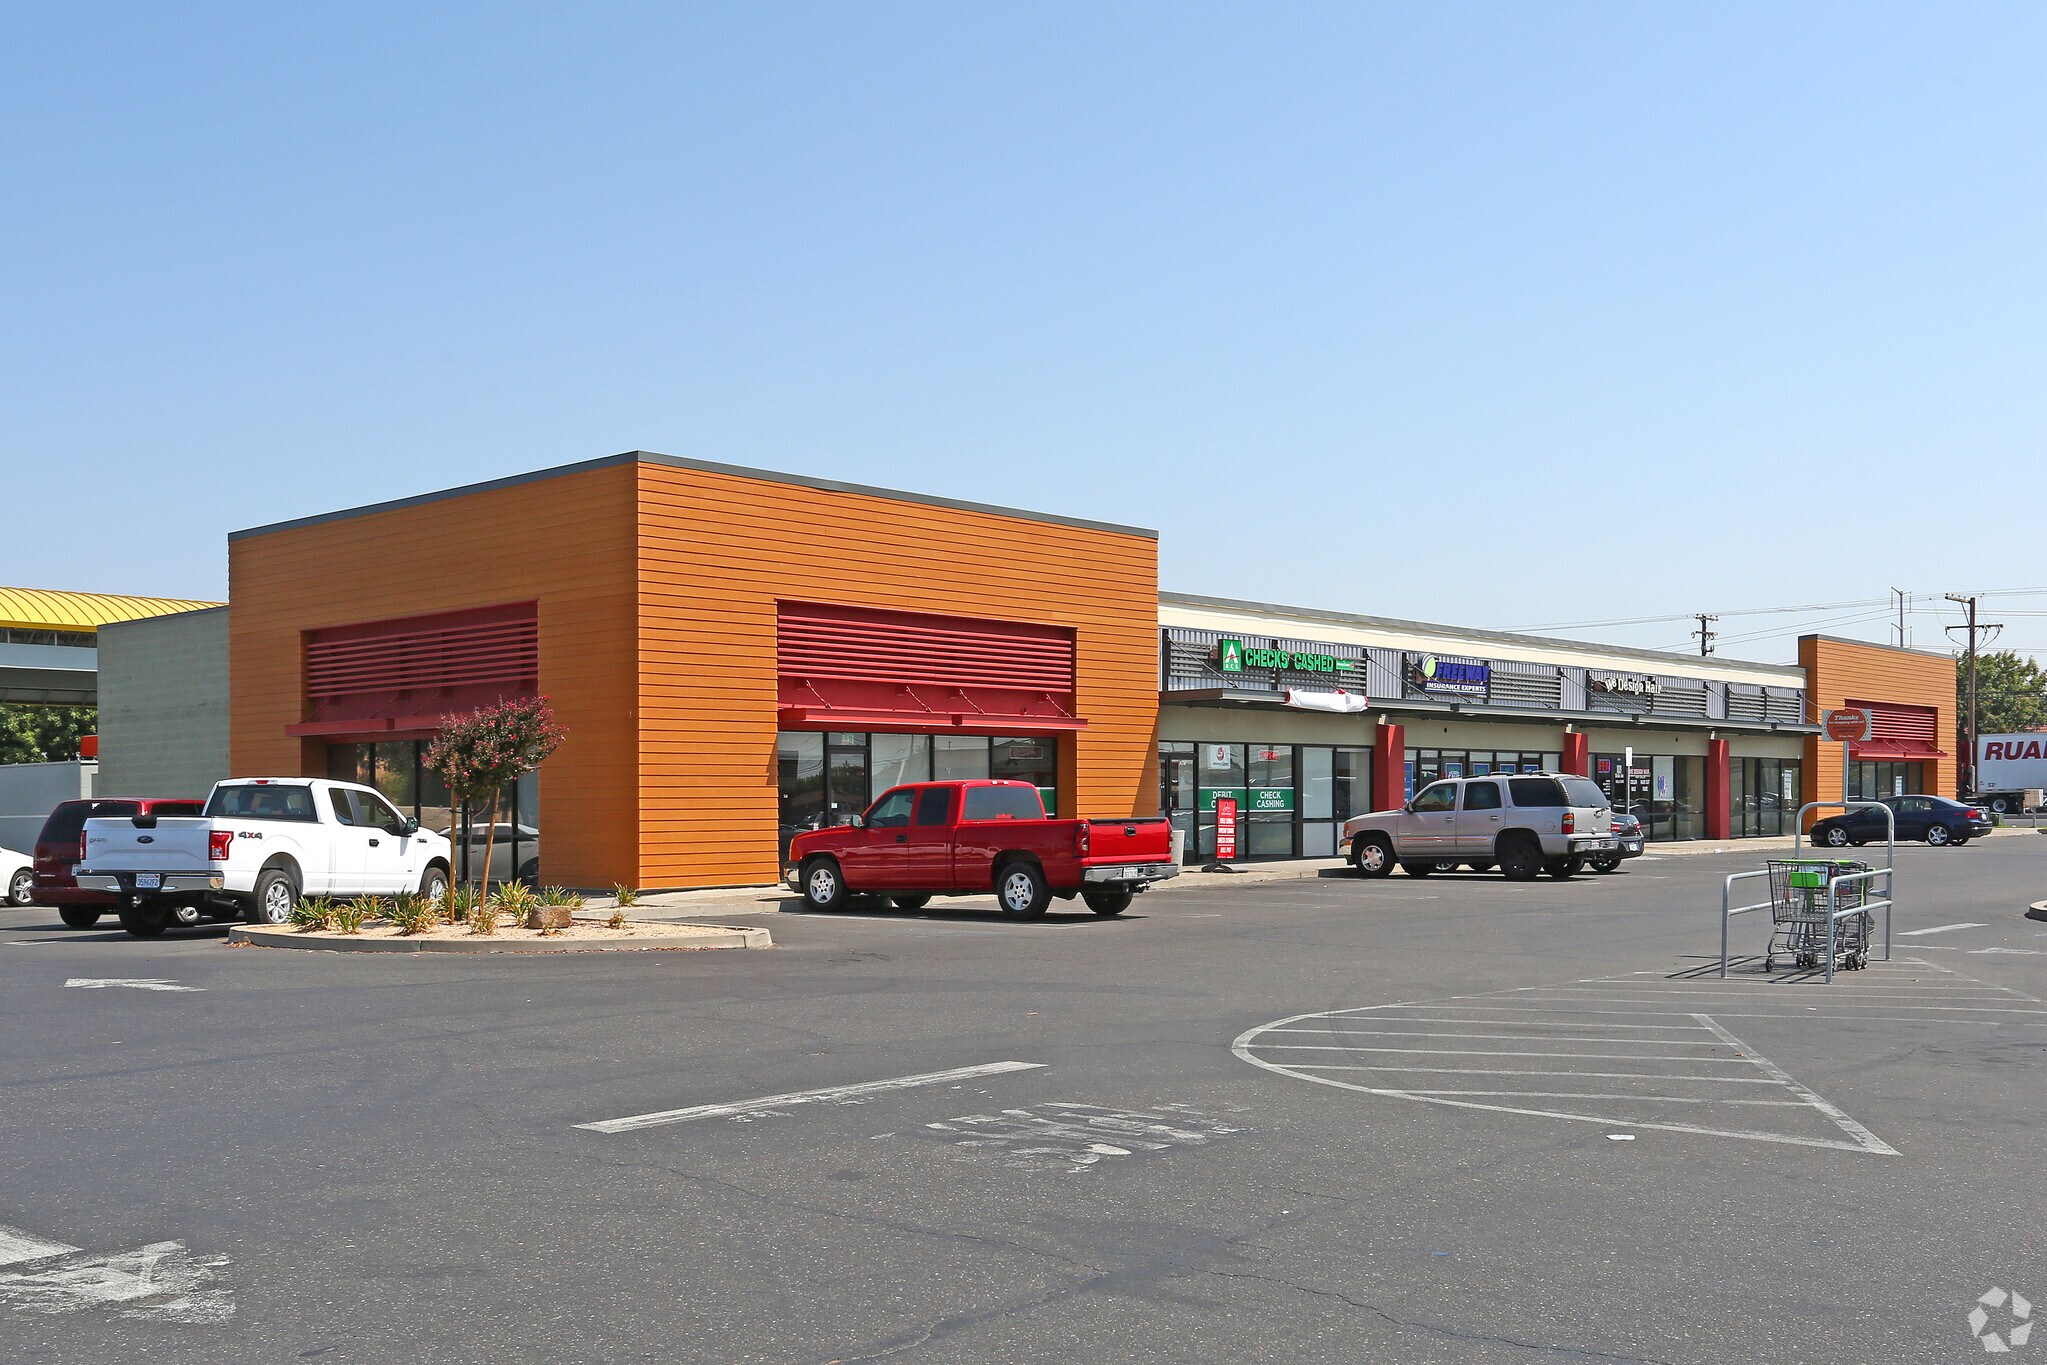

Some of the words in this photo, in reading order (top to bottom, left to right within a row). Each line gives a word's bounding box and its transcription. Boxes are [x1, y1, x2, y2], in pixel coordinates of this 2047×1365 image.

[1245, 647, 1289, 669] CHECKS
[1294, 652, 1334, 672] CASHED
[1436, 662, 1489, 682] FREEWAY
[1426, 682, 1461, 690] INSURANCE
[1461, 684, 1487, 692] EXPERTS
[1617, 678, 1644, 695] Design
[1645, 680, 1661, 694] Hair
[1984, 740, 2047, 760] RUA
[1256, 800, 1285, 808] CASHING
[1259, 791, 1282, 800] CHECK
